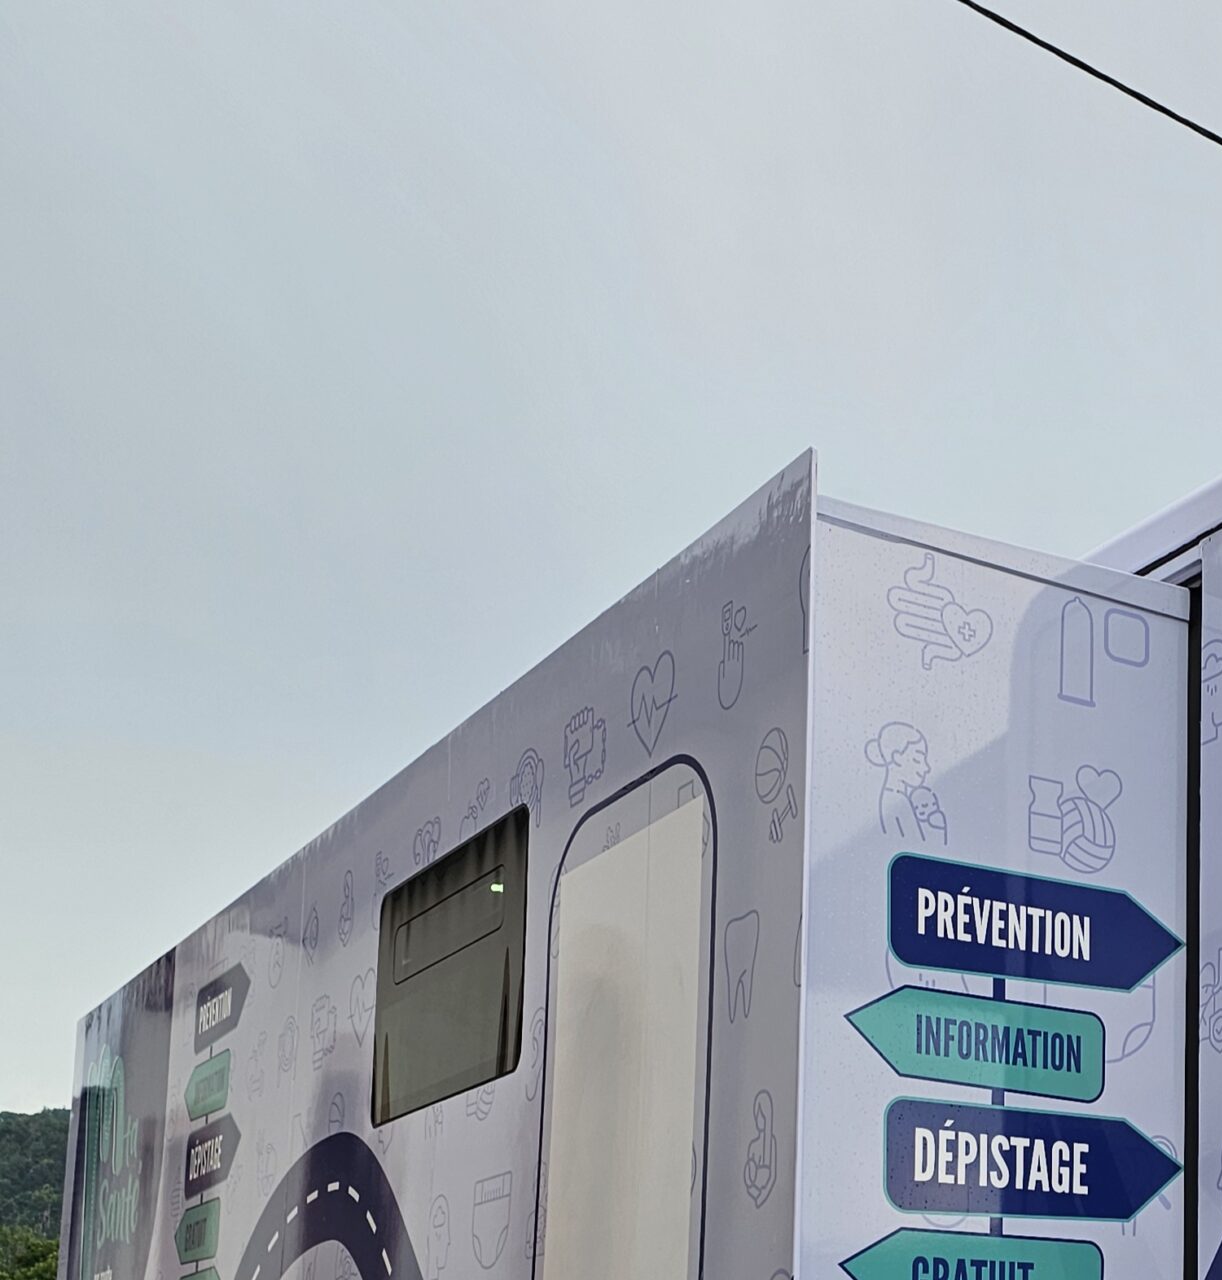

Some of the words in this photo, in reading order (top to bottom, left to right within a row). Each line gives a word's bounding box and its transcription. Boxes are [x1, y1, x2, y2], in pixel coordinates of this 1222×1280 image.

[916, 887, 1091, 961] PRÉVENTION
[915, 1013, 1082, 1074] INFORMATION
[189, 1134, 223, 1181] DÉPISTAGE
[913, 1119, 1089, 1195] DÉPISTAGE
